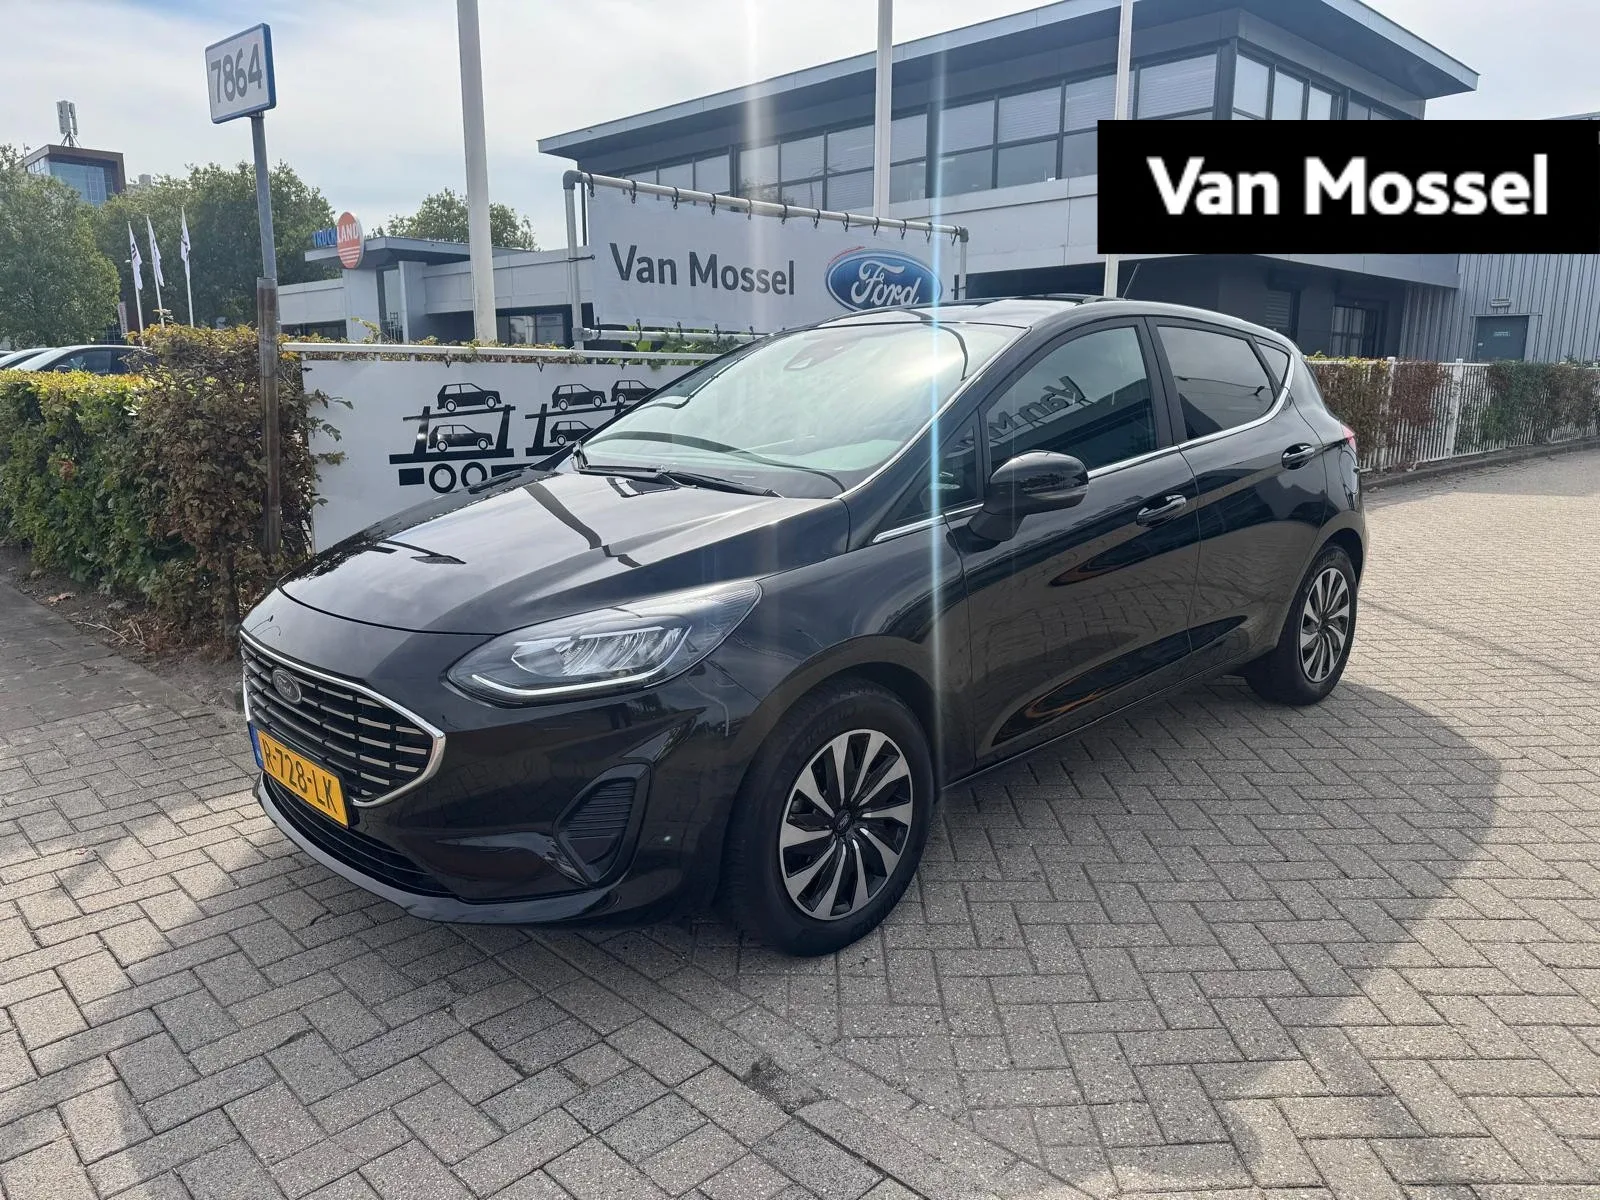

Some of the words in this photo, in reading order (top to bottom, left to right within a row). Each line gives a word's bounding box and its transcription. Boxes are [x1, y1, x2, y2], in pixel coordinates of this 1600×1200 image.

[211, 43, 262, 103] 7864
[609, 242, 677, 285] Van
[689, 251, 794, 295] Mossel
[851, 260, 921, 305] Ford
[262, 738, 337, 813] R-728-LK
